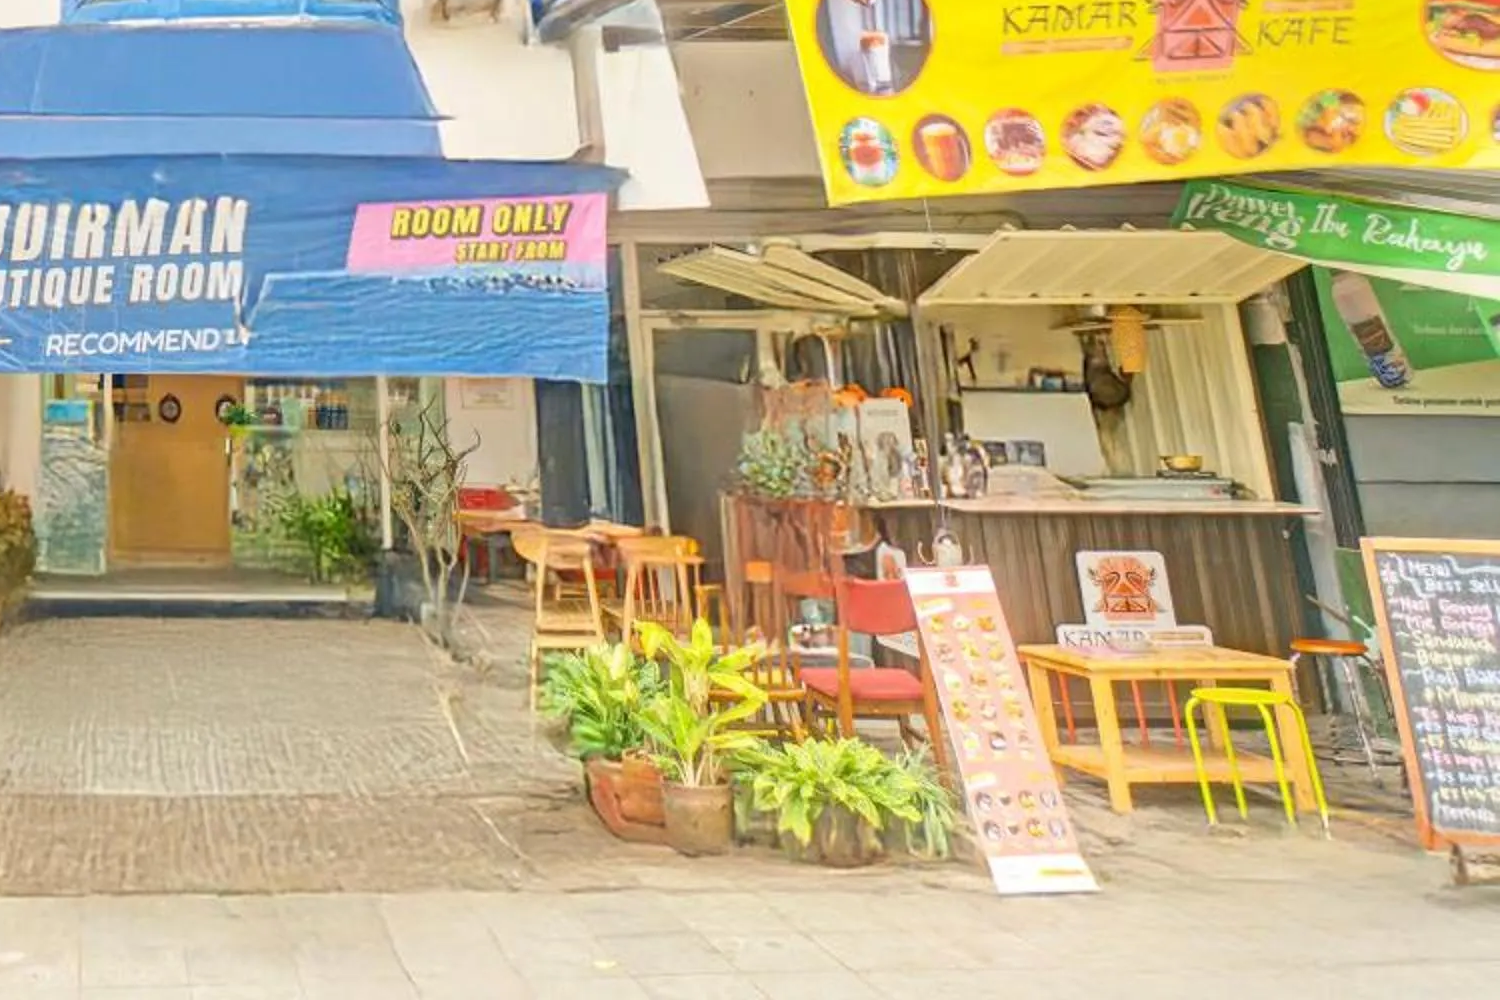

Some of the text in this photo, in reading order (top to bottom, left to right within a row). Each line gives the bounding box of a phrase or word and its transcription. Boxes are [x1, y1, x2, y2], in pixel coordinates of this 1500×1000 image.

[1002, 1, 1137, 35] KAMAR
[1257, 17, 1355, 46] KAFE
[391, 202, 572, 239] ROOM ONLY
[455, 240, 566, 263] START FROM
[130, 260, 244, 302] ROOM
